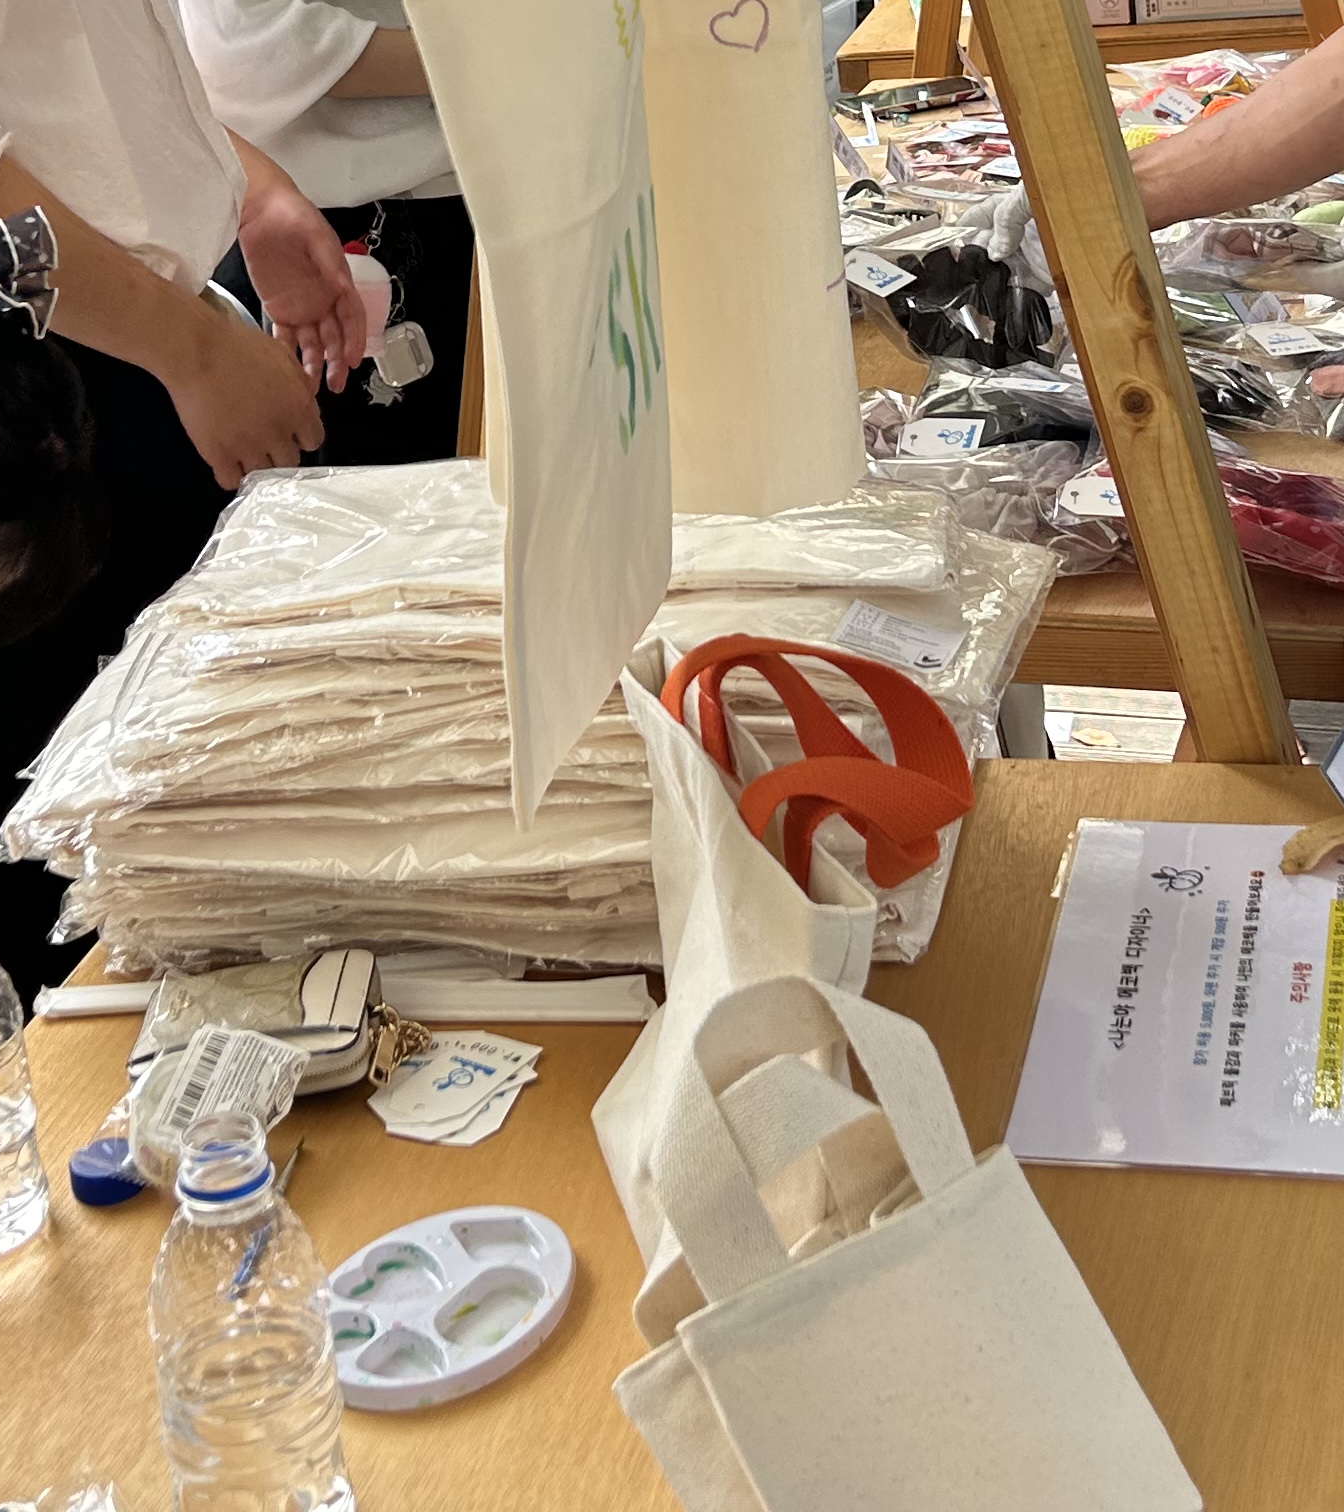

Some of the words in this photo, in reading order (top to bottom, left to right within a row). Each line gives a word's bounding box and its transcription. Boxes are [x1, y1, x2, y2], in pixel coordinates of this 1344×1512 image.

[1123, 906, 1155, 958] 디자이너>
[1114, 963, 1144, 998] 에코백
[1230, 984, 1251, 1017] 사용하여
[1288, 961, 1313, 1003] 주의사항
[1104, 1003, 1136, 1050] <나는야
